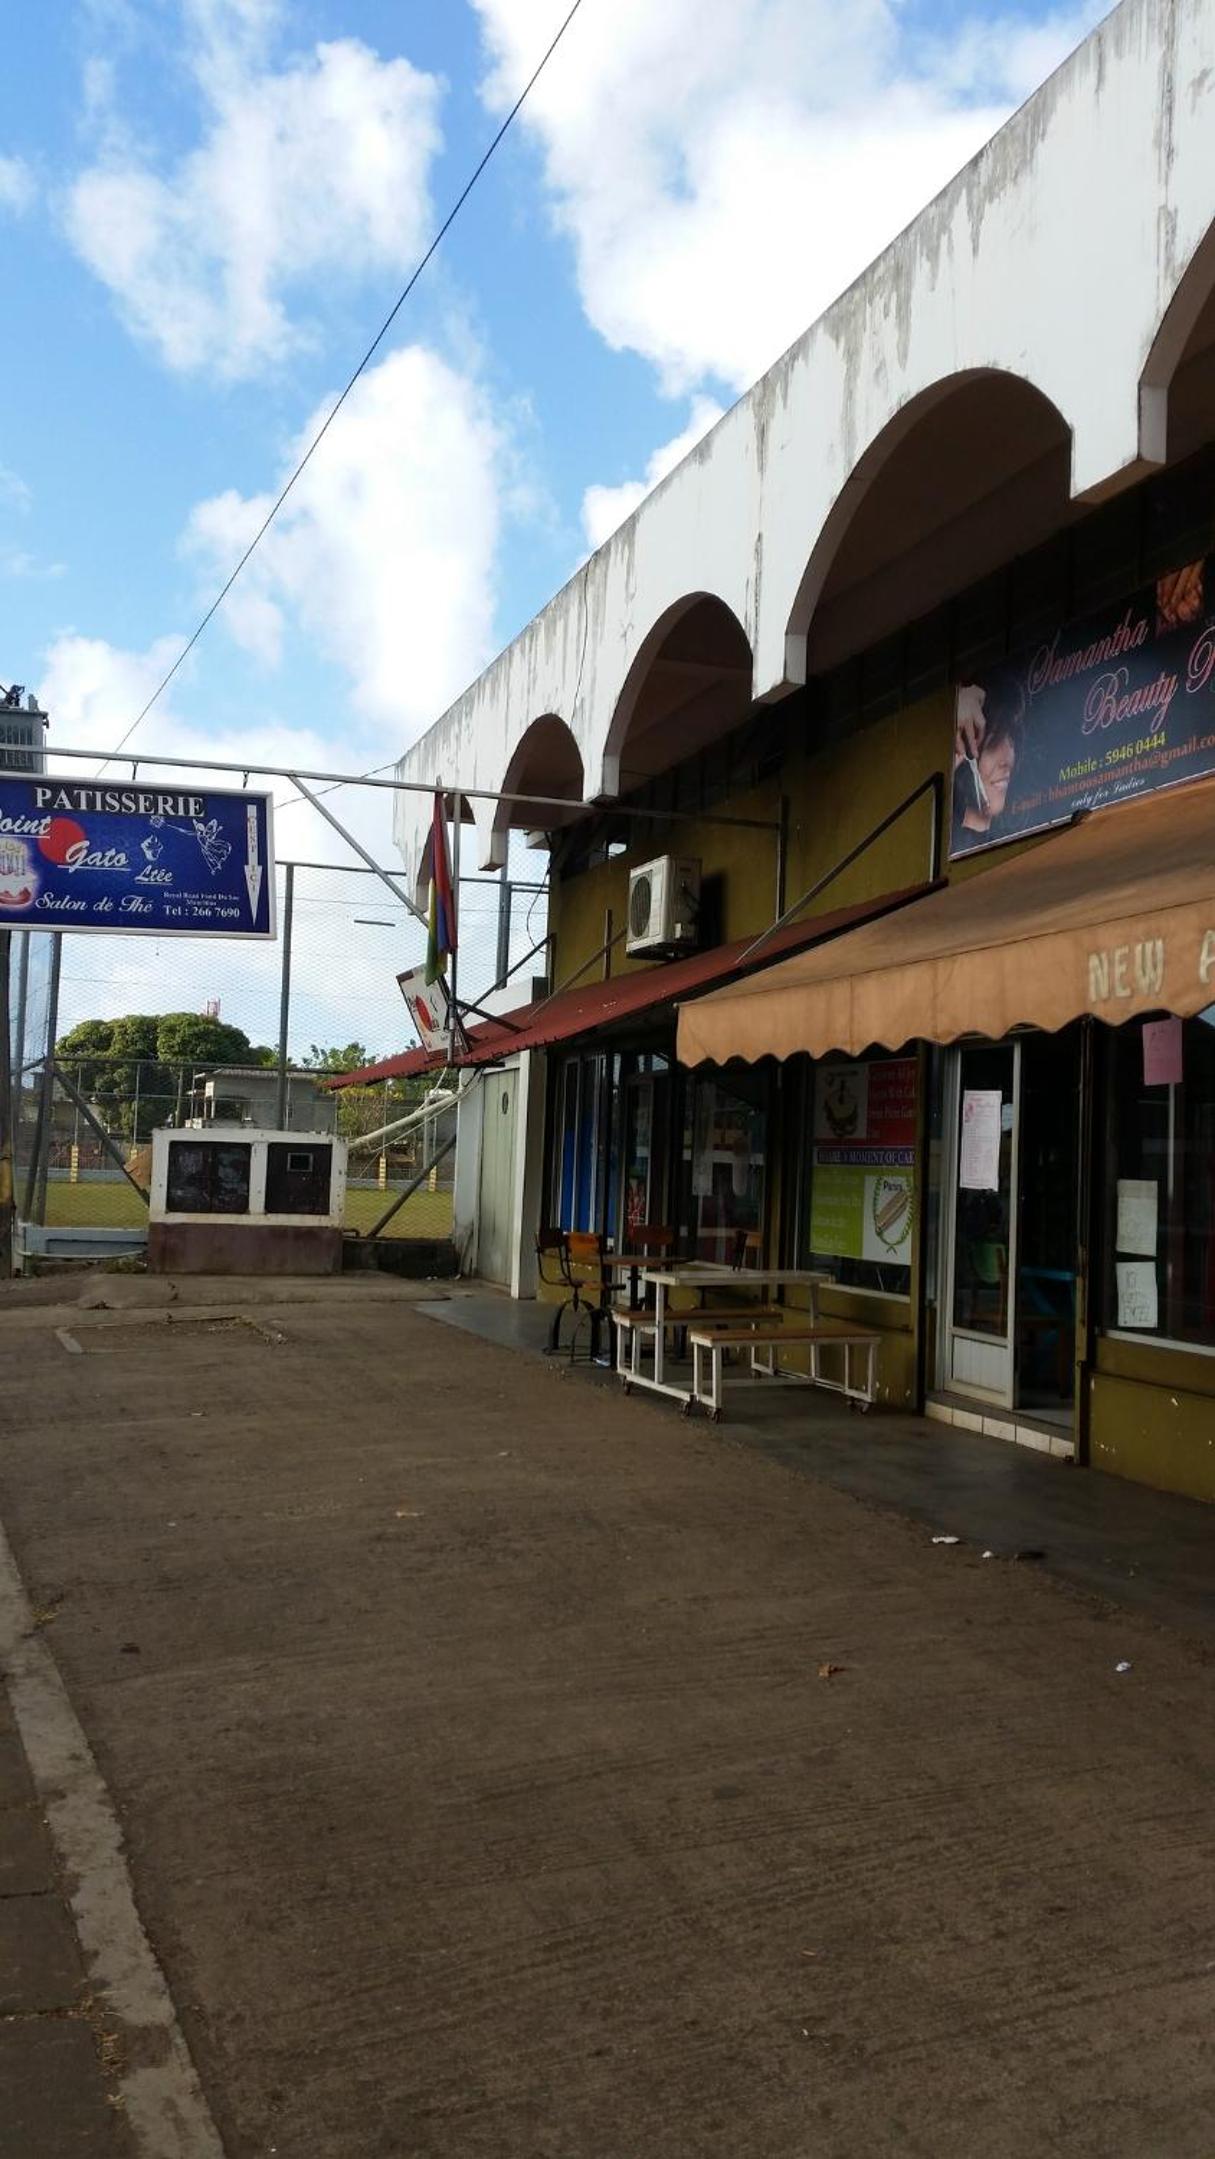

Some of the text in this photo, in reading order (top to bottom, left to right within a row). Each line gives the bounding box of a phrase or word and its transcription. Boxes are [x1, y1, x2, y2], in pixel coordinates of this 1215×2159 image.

[1027, 607, 1150, 695] Samantha
[1081, 666, 1179, 735] Beauty
[1058, 757, 1098, 782] Mobile
[1104, 743, 1134, 767] 5946
[1135, 731, 1167, 757] 0444
[34, 786, 205, 817] PATISSERIE
[0, 808, 51, 835] oint
[65, 840, 129, 874] Gato
[35, 891, 88, 911] Salon
[93, 896, 113, 912] de
[163, 904, 182, 915] Tel
[191, 906, 212, 917] 266
[214, 907, 240, 918] 7690
[1089, 938, 1164, 1002] NEW
